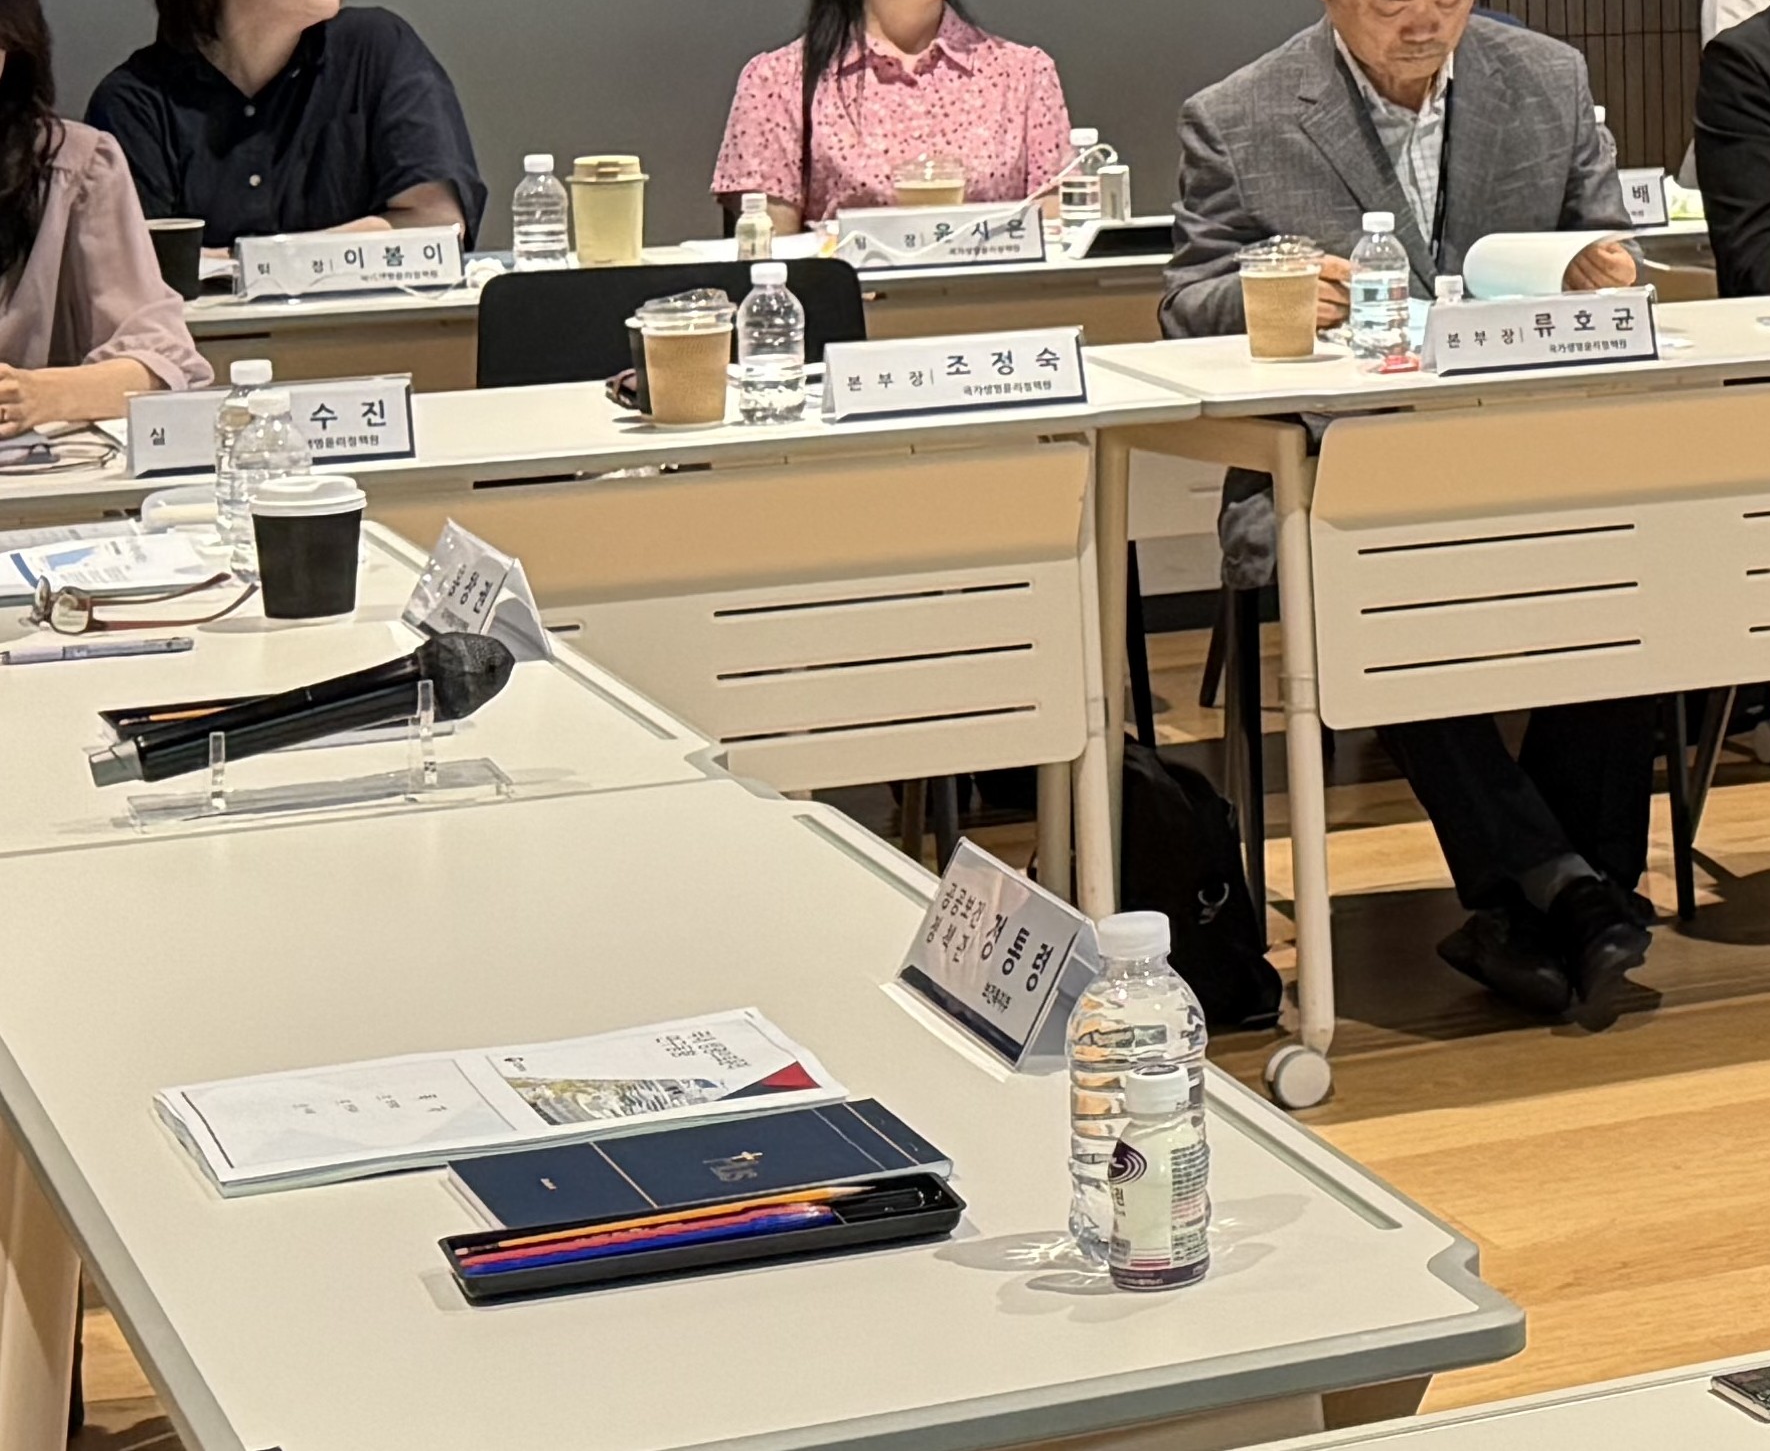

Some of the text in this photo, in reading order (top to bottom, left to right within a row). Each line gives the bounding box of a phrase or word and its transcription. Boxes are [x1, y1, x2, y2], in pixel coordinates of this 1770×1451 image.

[343, 242, 443, 269] 이봄이
[1534, 308, 1635, 338] 류호균
[847, 347, 1060, 391] 본부장 조정숙
[150, 399, 387, 446] 실 수진
